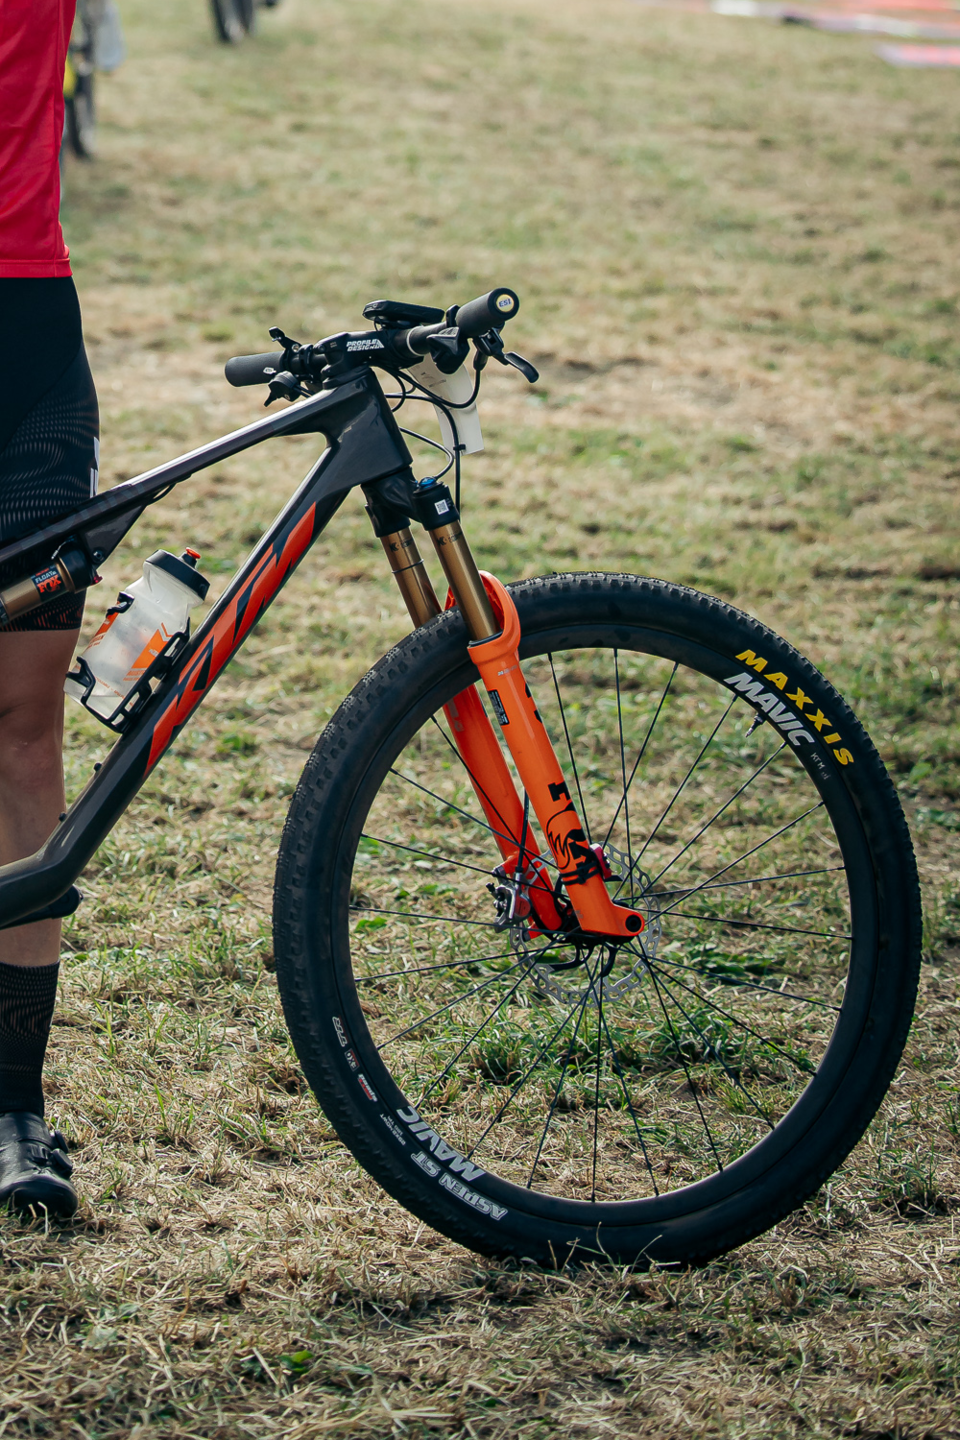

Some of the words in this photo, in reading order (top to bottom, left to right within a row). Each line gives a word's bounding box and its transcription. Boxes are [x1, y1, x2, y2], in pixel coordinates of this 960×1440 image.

[498, 298, 512, 307] ESI
[346, 339, 378, 347] PROFILE
[37, 574, 62, 594] FOX
[723, 672, 815, 746] MAVIC
[735, 649, 854, 766] MAXXIS
[396, 1106, 486, 1182] MAVIC
[438, 1172, 508, 1221] ASPEN
